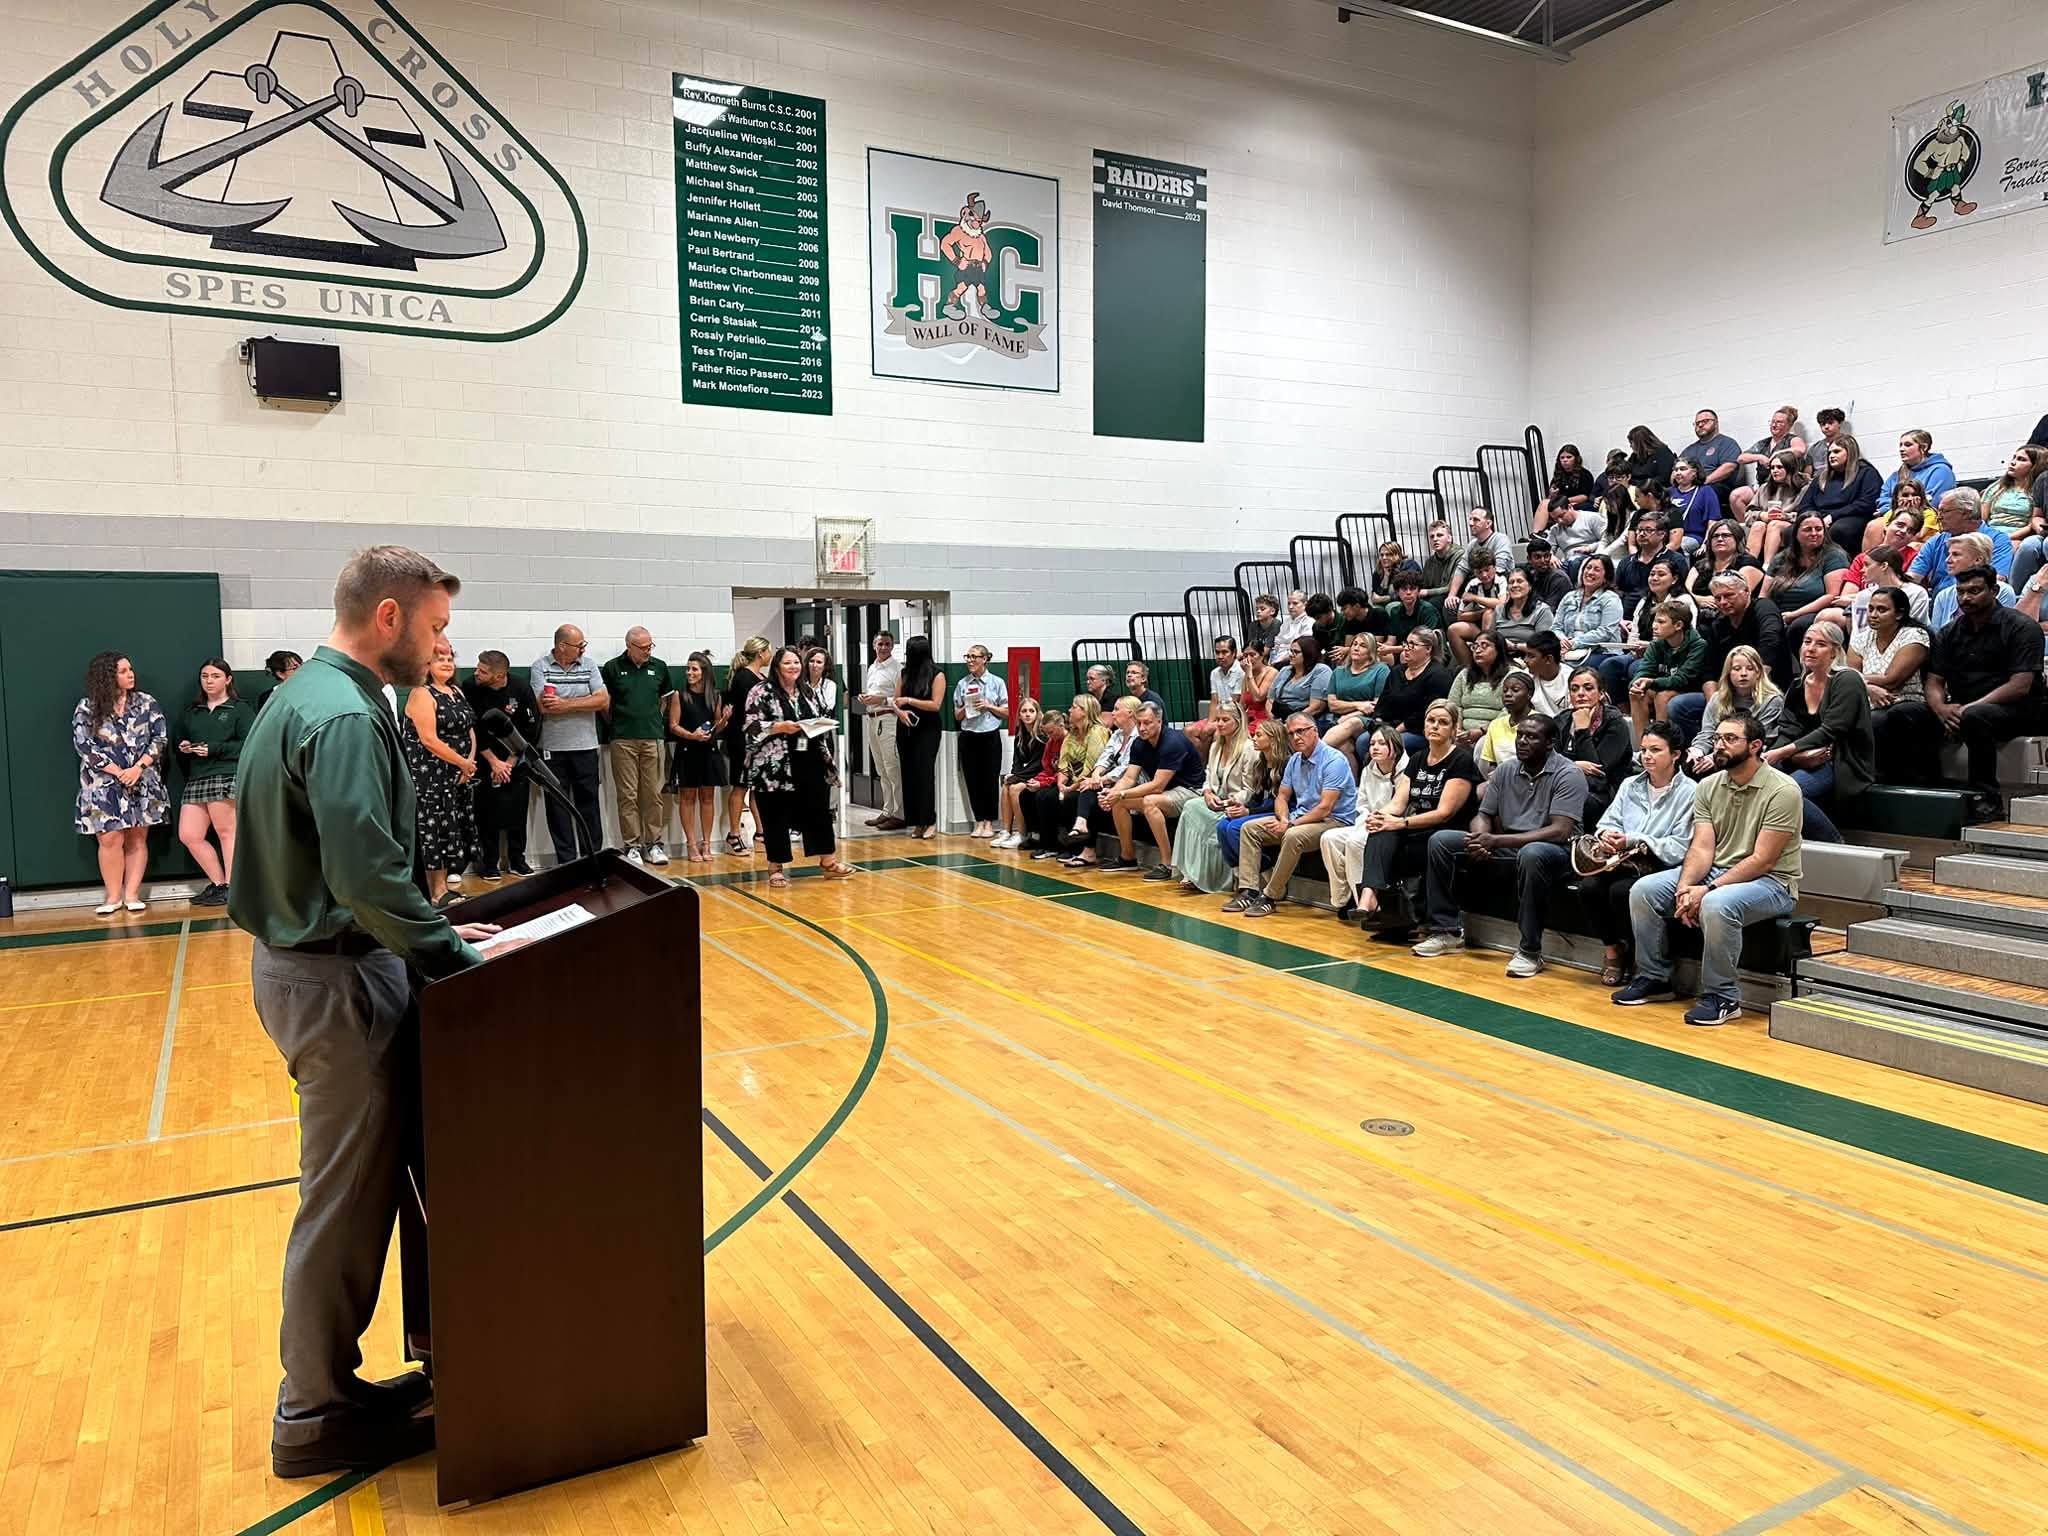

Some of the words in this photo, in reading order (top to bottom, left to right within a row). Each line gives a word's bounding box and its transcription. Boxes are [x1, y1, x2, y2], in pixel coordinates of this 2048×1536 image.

[72, 0, 219, 108] HOLY
[368, 18, 522, 171] CROSS
[683, 88, 702, 100] Rev.
[704, 92, 739, 107] Kenneth
[742, 99, 766, 111] Burns
[769, 104, 793, 116] C.S.C.
[795, 109, 816, 120] 2001
[728, 113, 768, 129] Warburton
[771, 121, 794, 133] C.S.C.
[796, 125, 816, 136] 2001
[685, 124, 738, 140] Jacqueline
[741, 134, 776, 146] Witoski
[796, 142, 817, 153] 2001
[685, 141, 711, 155] Buffy
[714, 146, 763, 161] Alexander
[796, 159, 817, 170] 2002
[686, 158, 726, 173] Matthew
[730, 165, 758, 178] Swick
[797, 176, 817, 187] 2002
[1107, 165, 1194, 197] RAIDERS
[686, 176, 723, 189] Michael
[726, 182, 754, 194] Shara
[797, 192, 817, 203] 2003
[1115, 188, 1140, 198] HALL
[1145, 192, 1155, 200] OF
[1161, 196, 1186, 206] FAME
[687, 193, 726, 207] Jennifer
[730, 199, 761, 211] Hollett
[798, 209, 818, 219] 2004
[1102, 198, 1122, 209] David
[1124, 202, 1156, 215] Thomson
[1184, 212, 1200, 222] 2023
[687, 210, 731, 224] Marianne
[734, 216, 758, 228] Allen
[798, 225, 819, 236] 2005
[688, 227, 711, 239] Jean
[714, 231, 760, 246] Newberry
[798, 242, 819, 253] 2006
[688, 244, 709, 256] Paul
[713, 248, 754, 261] Bertrand
[799, 259, 819, 269] 2008
[688, 262, 727, 275] Maurice
[730, 267, 793, 283] Charbonneau
[799, 275, 820, 286] 2009
[166, 272, 287, 309] SPES
[319, 287, 453, 324] UNICA
[689, 279, 730, 292] Matthew
[732, 284, 754, 294] Vinc
[799, 292, 820, 302] 2010
[690, 296, 716, 307] Brian
[719, 299, 744, 312] Carty
[801, 308, 821, 319] 2011
[690, 313, 720, 325] Carrie
[723, 316, 757, 328] Stasiak
[800, 325, 821, 336] 2012
[690, 329, 724, 342] Rosaly
[727, 333, 766, 345] Petriello
[800, 341, 821, 351] 2014
[913, 324, 952, 341] WALL
[959, 322, 979, 336] OF
[984, 327, 1025, 353] FAME
[692, 345, 715, 356] Tess
[717, 348, 747, 360] Trojan
[801, 357, 822, 367] 2016
[692, 362, 724, 374] Father
[726, 366, 748, 376] Rico
[751, 368, 788, 380] Passero
[801, 373, 823, 383] 2019
[693, 379, 716, 390] Mark
[719, 382, 769, 394] Montefiore
[802, 389, 823, 399] 2023
